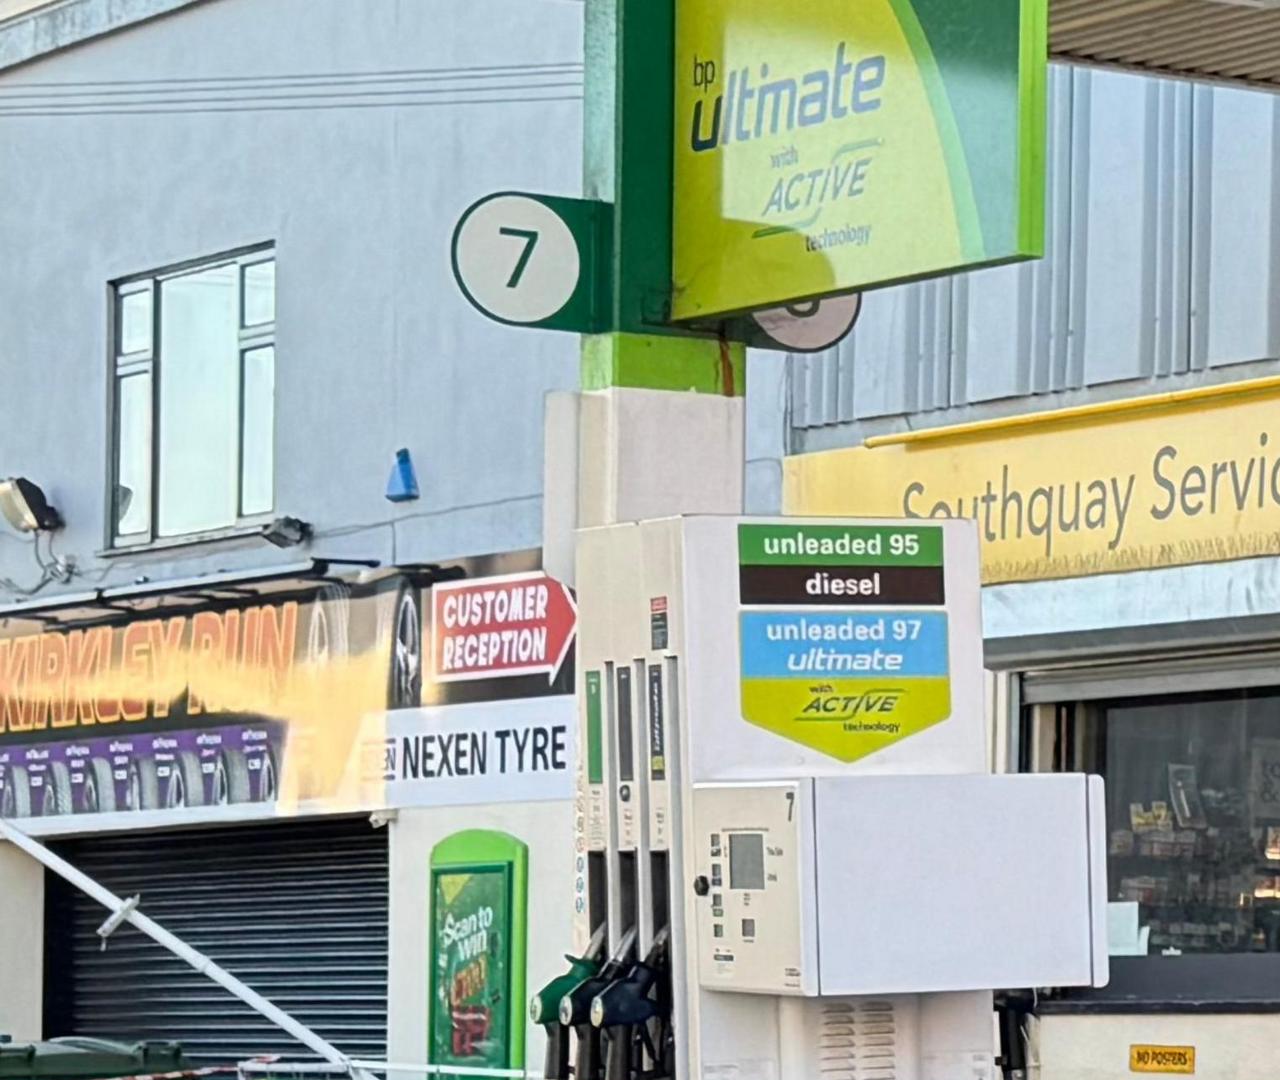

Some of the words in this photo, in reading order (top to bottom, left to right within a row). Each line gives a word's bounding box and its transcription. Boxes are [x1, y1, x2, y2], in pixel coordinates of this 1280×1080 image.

[693, 53, 715, 92] bp
[691, 41, 885, 153] ultimate
[770, 145, 799, 168] with
[762, 157, 873, 217] ACTIVE
[806, 224, 872, 252] technology
[499, 226, 539, 289] 7
[764, 533, 881, 556] unleaded
[889, 535, 919, 556] 95
[805, 572, 880, 595] diesel
[443, 585, 549, 628] CUSTOMER
[767, 618, 885, 641] unleaded
[892, 619, 922, 641] 97
[442, 627, 548, 670] RECEPTION
[787, 647, 903, 671] ultimate
[803, 695, 898, 713] ACTIVE
[809, 685, 833, 694] with
[843, 721, 901, 733] technology
[402, 731, 487, 780] NEXEN
[495, 725, 566, 773] TYRE
[785, 792, 795, 822] 7
[443, 912, 477, 946] Scan
[478, 905, 493, 929] to
